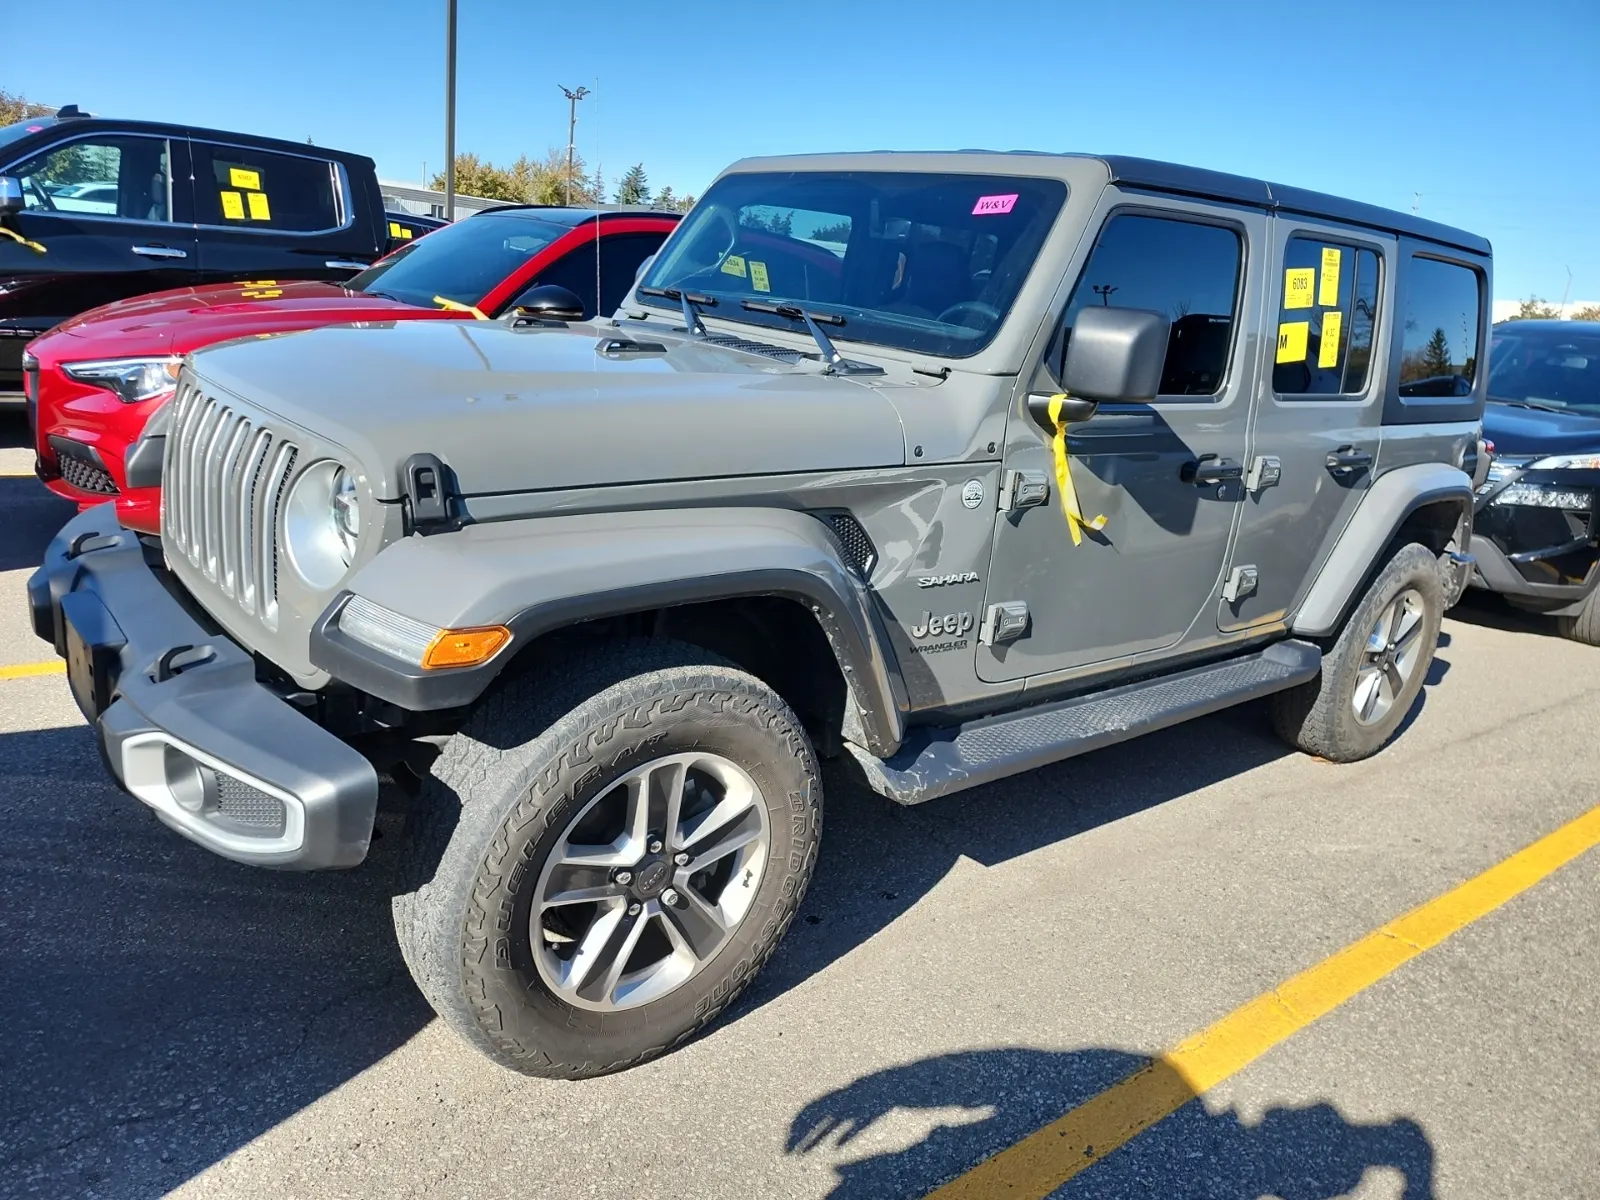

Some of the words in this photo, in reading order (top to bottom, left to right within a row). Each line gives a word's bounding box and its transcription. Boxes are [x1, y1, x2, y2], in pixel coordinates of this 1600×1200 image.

[980, 199, 1012, 210] W&V
[1292, 277, 1308, 290] 6083
[1279, 334, 1288, 349] M
[917, 571, 980, 589] SAHARA
[911, 610, 974, 639] Jeep
[909, 639, 968, 654] WRANGLER
[495, 764, 602, 970] DUELER
[694, 790, 807, 1020] BRIDGESTONE
